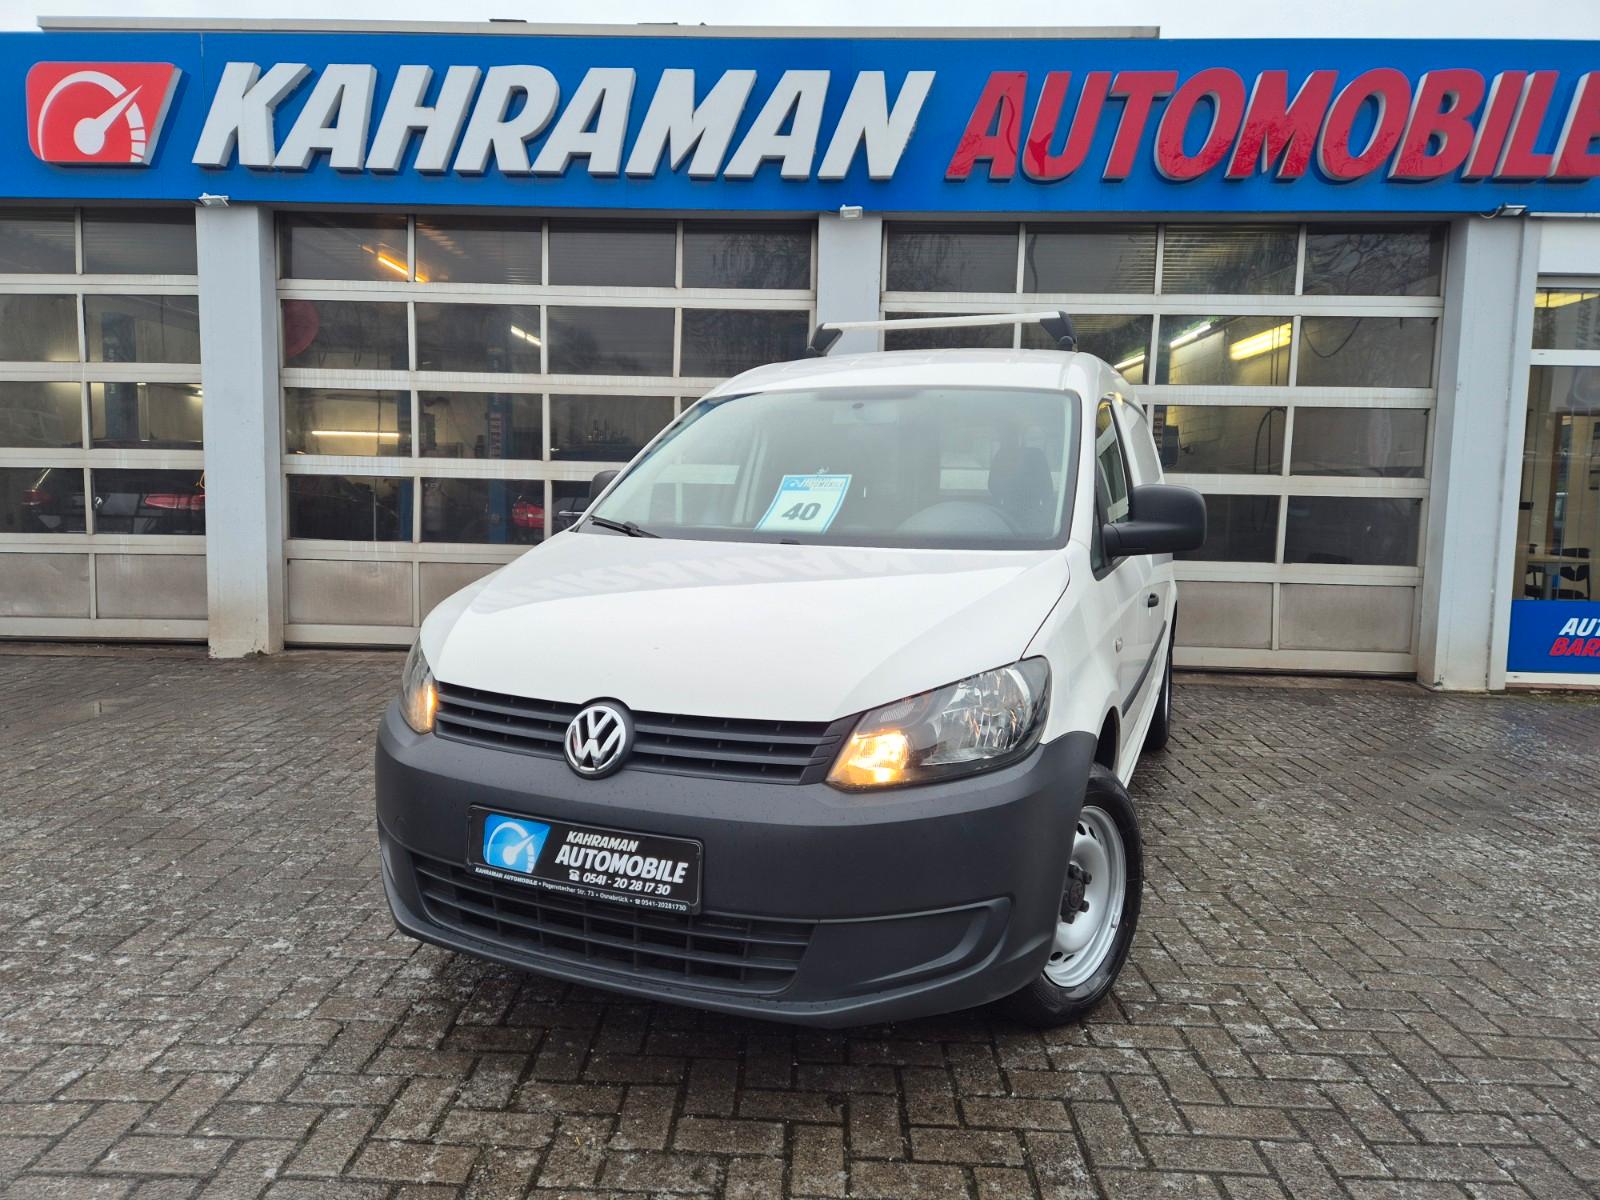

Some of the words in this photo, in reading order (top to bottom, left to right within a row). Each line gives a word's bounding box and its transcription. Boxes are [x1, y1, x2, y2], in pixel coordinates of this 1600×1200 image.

[191, 61, 936, 180] KAHRAMAN
[781, 502, 821, 521] 40
[1549, 637, 1600, 657] BAR
[566, 831, 639, 852] KAHRAMAN
[554, 844, 689, 884] AUTOMOBILE
[474, 867, 503, 879] KAHRAMAN
[503, 874, 538, 886] AUTOMOBILE
[599, 893, 629, 903] Osnabrück
[583, 872, 607, 886] 0541
[613, 878, 627, 889] 20
[629, 880, 643, 891] 28
[644, 882, 654, 892] 17
[655, 884, 671, 896] 30
